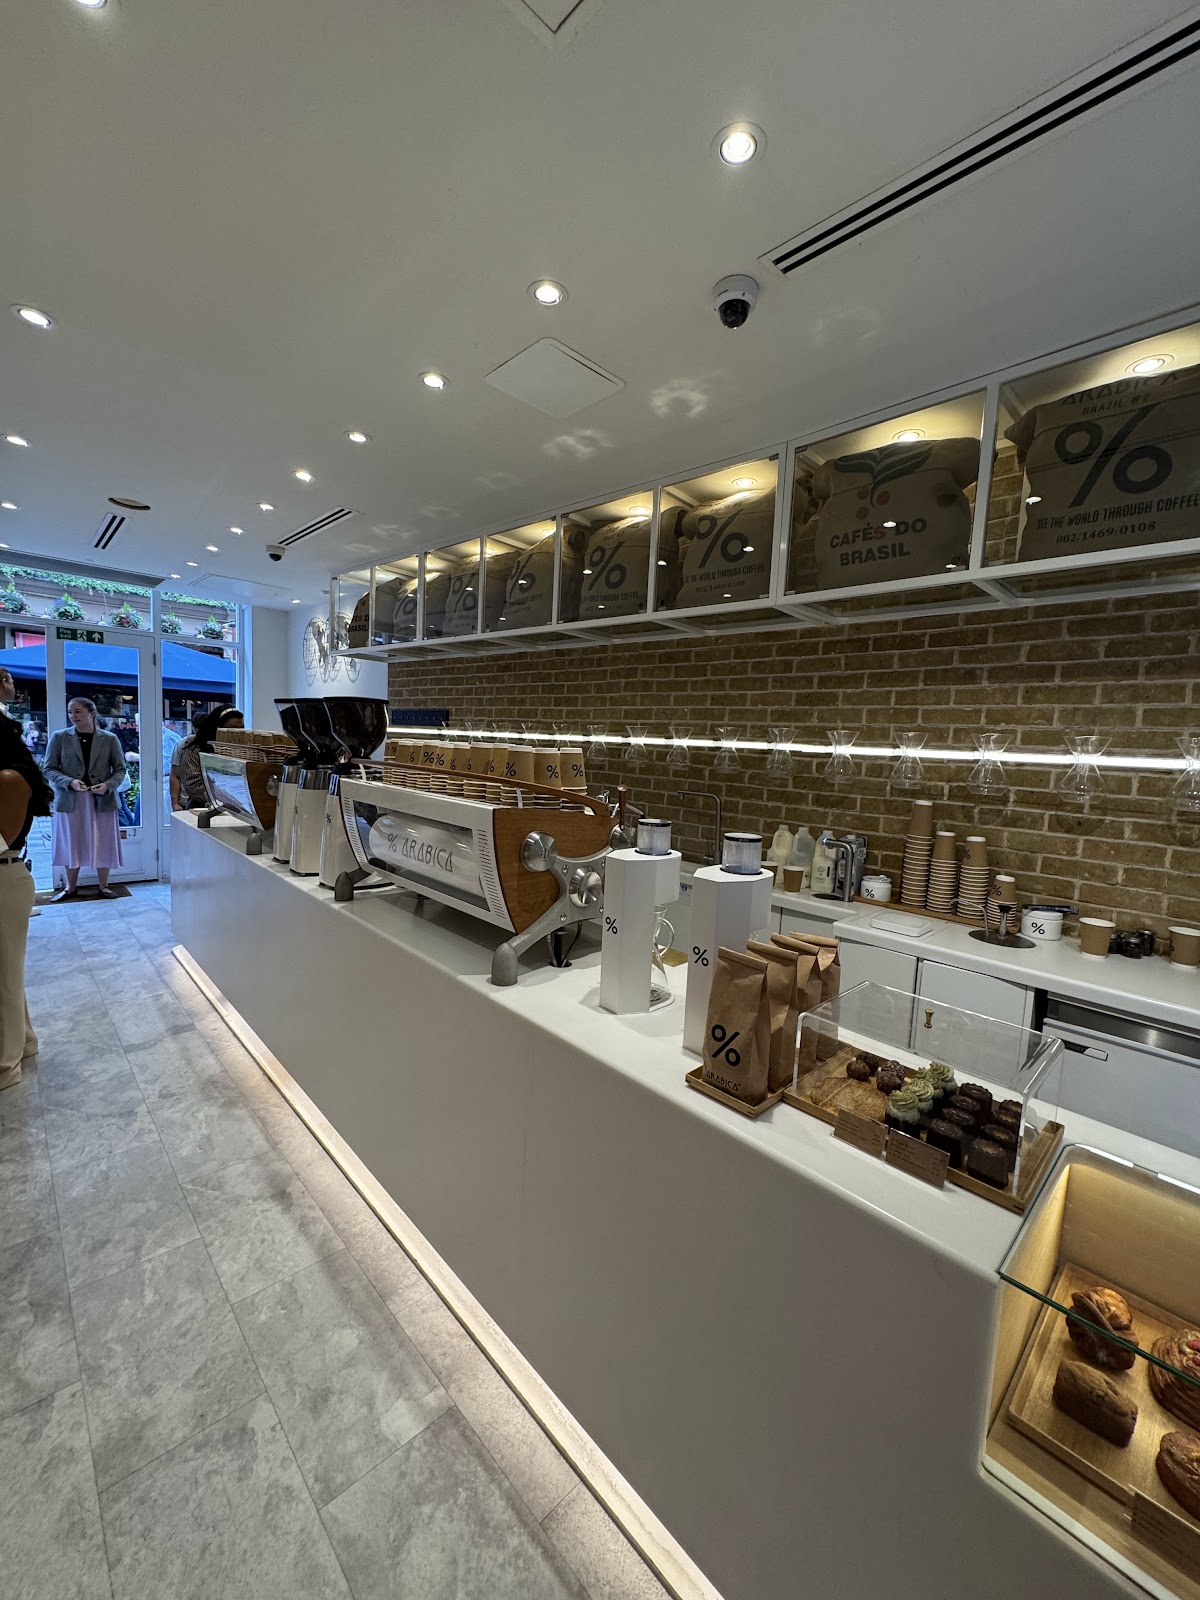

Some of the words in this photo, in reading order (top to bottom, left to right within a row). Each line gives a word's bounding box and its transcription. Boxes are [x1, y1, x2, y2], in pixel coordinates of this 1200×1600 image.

[1082, 400, 1122, 416] BRAZIL
[1050, 515, 1065, 529] THE
[1067, 510, 1099, 526] WORLD
[1103, 500, 1152, 521] THROUGH
[1156, 493, 1200, 512] COFFEE
[829, 523, 887, 549] CAFÉS
[895, 518, 927, 536] DO
[1056, 521, 1156, 543] 002/1469/0108
[840, 542, 911, 566] BRASIL
[717, 567, 741, 579] THROUGH
[742, 563, 764, 575] COFFEE
[401, 837, 453, 873] ARABICA
[711, 1023, 741, 1067] %
[706, 1070, 739, 1092] ARABICA
